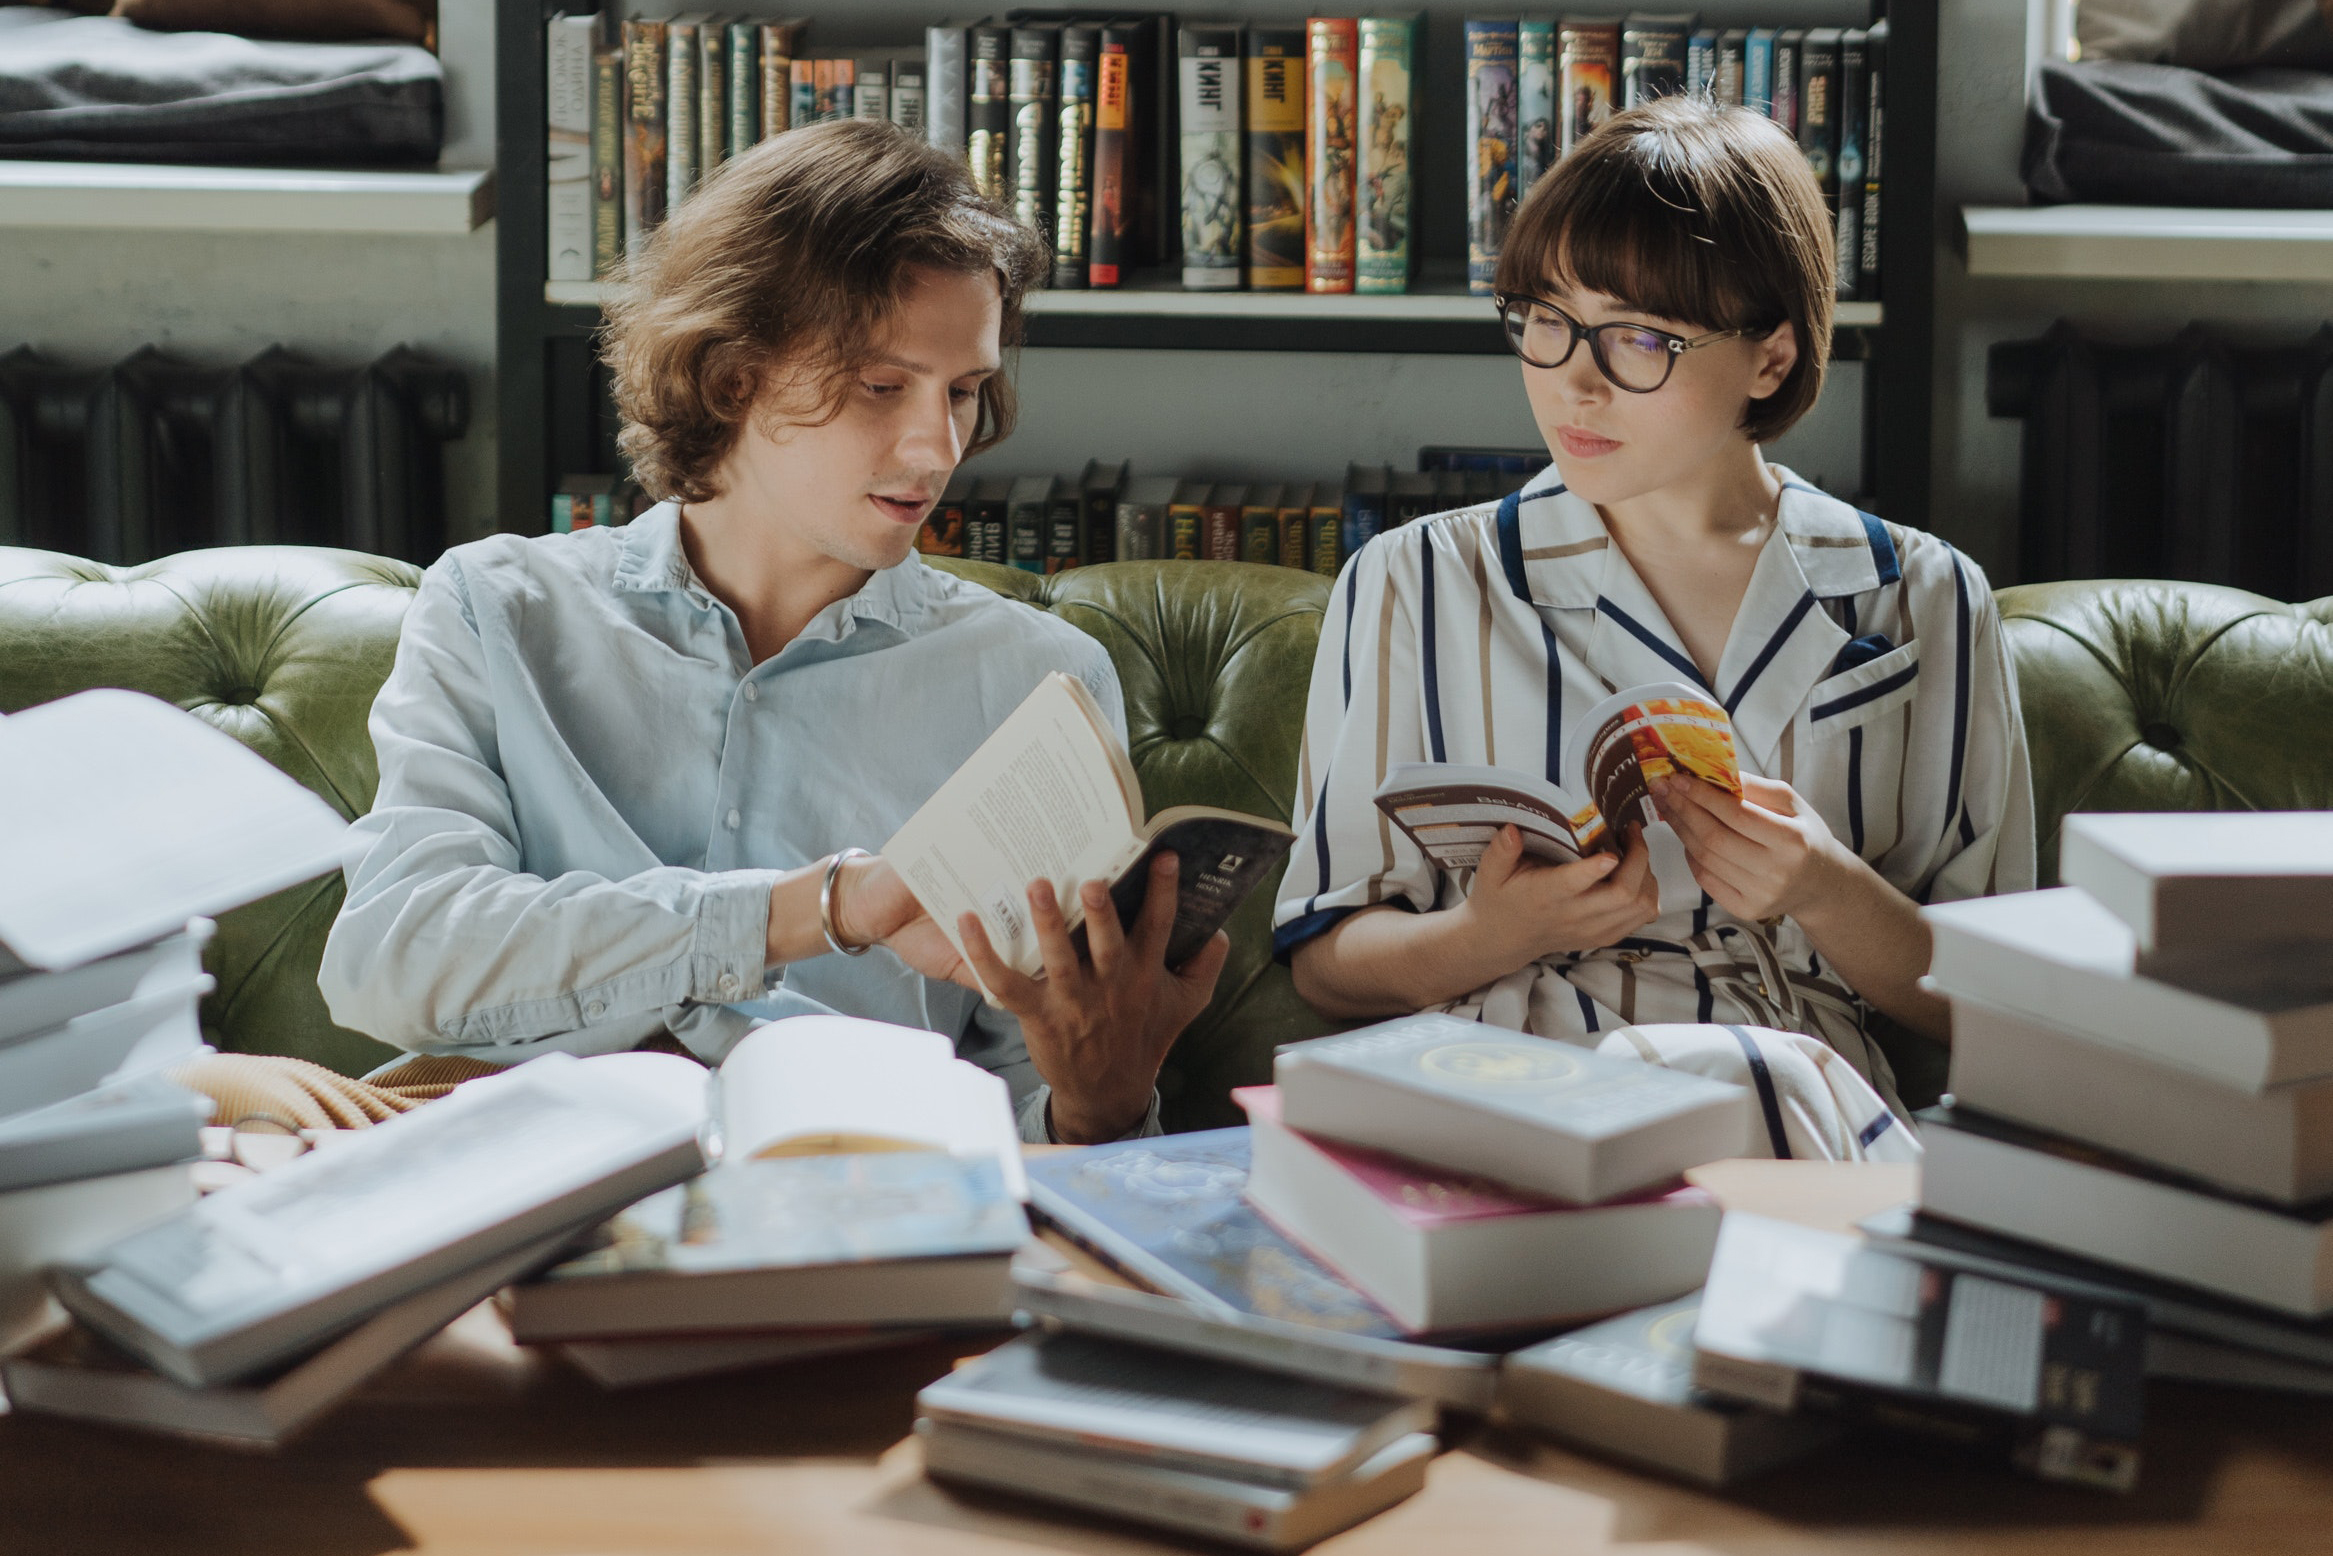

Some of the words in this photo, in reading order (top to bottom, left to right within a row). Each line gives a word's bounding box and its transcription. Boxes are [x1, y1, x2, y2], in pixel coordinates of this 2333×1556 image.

[552, 33, 568, 122] ПОТОМОК
[1197, 61, 1221, 110] КИНГ
[1263, 59, 1285, 102] КИНГ
[1864, 193, 1879, 225] BOOK
[1862, 227, 1877, 270] ESCAPE
[984, 522, 1001, 561] ЛИВ
[1476, 796, 1549, 819] Bel-Ami
[1199, 873, 1231, 887] HENRIK
